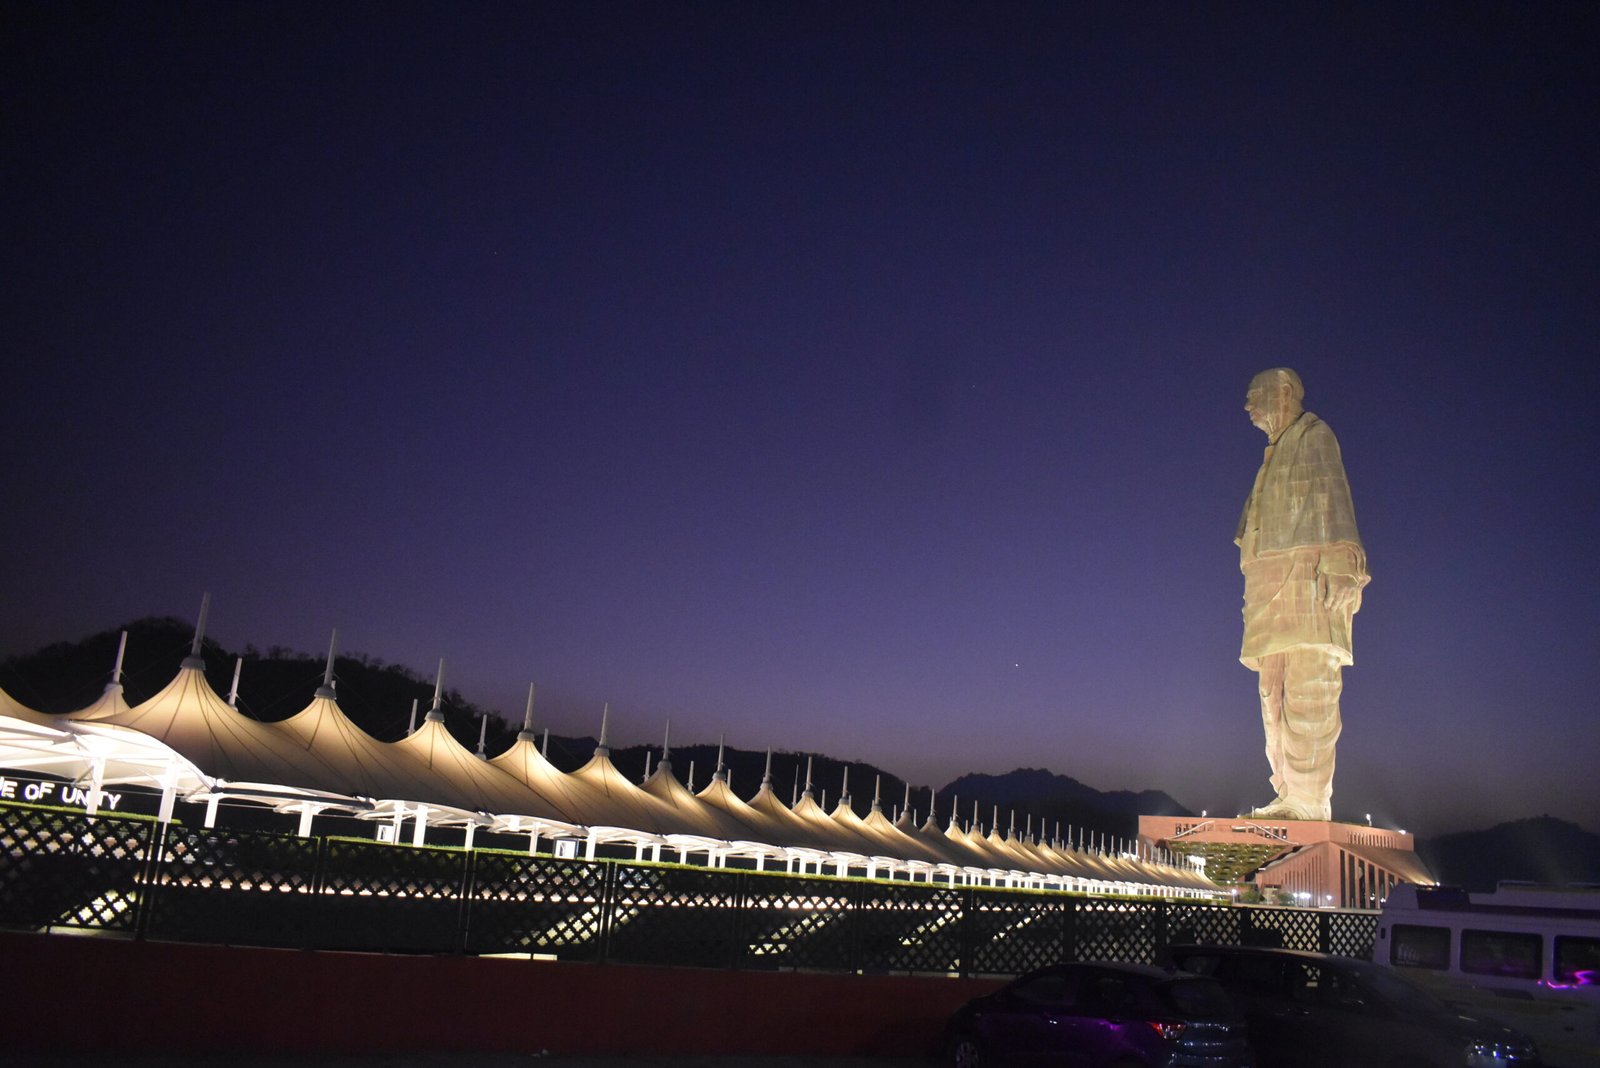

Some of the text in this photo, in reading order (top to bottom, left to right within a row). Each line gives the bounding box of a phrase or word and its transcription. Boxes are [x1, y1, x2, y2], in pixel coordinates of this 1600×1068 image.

[0, 777, 121, 810] E OF UNTY
